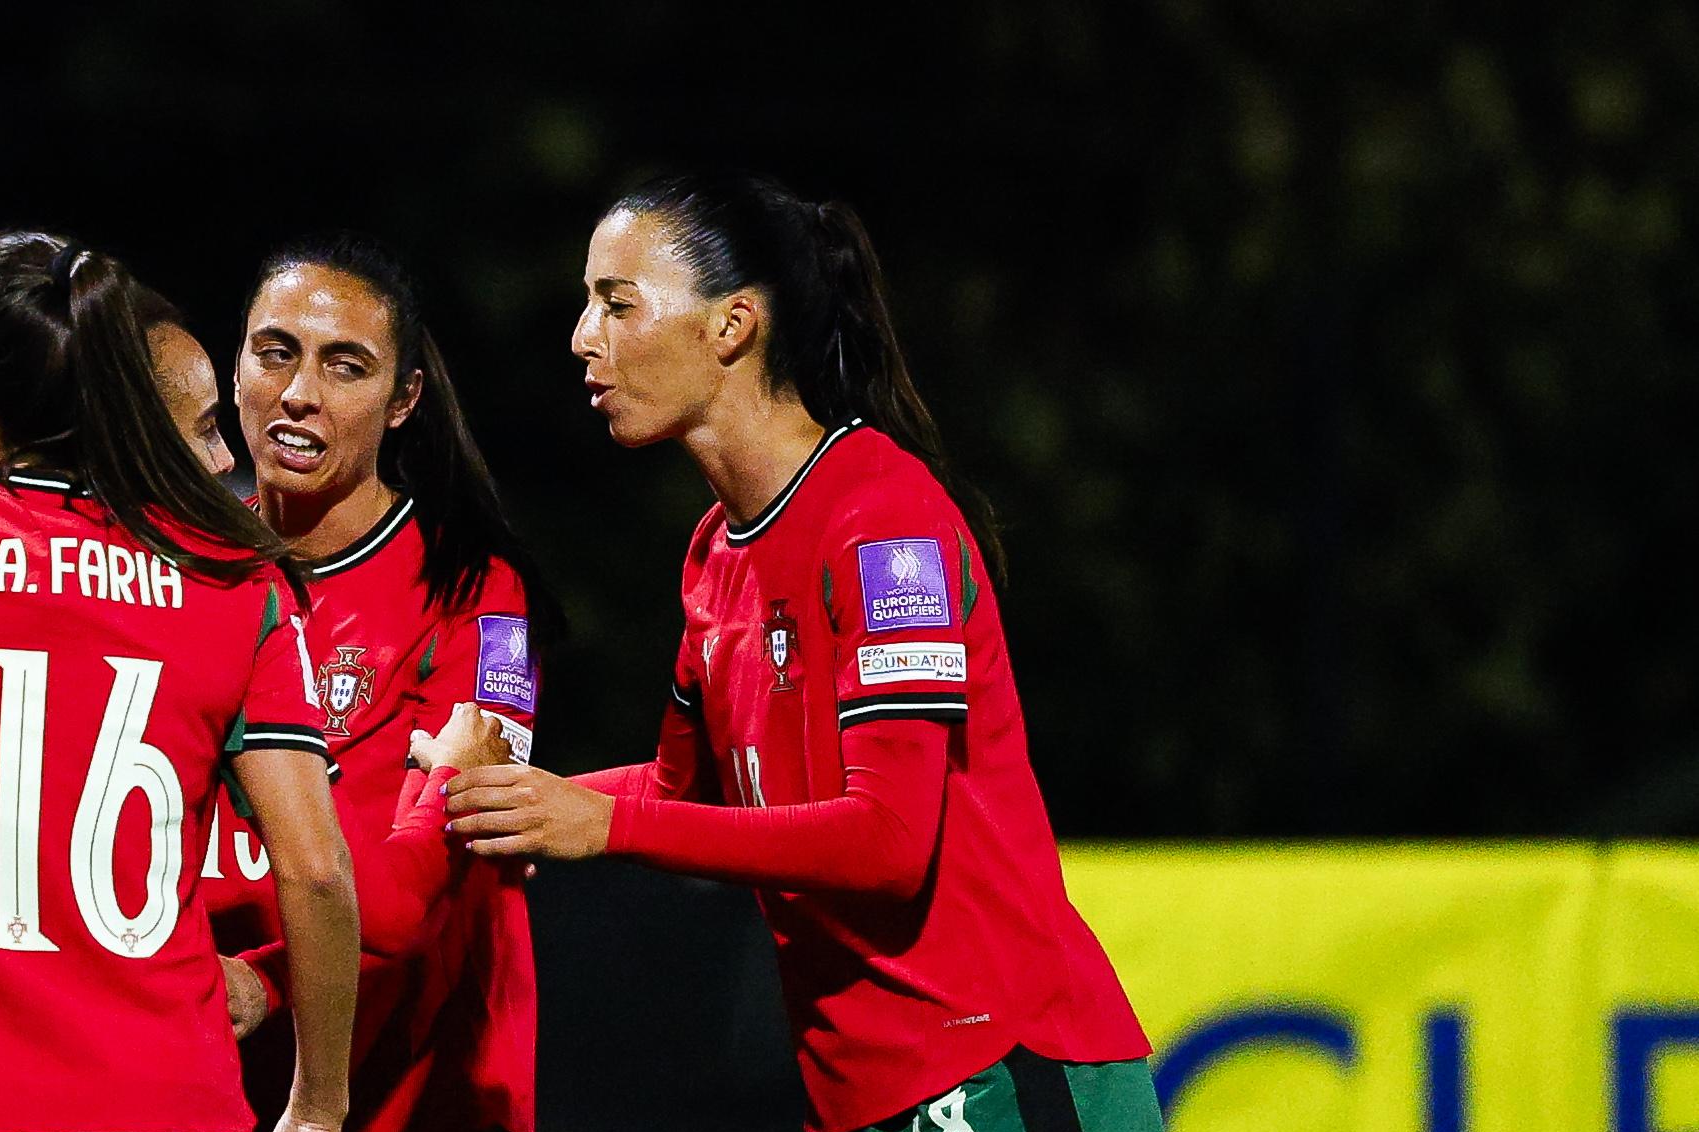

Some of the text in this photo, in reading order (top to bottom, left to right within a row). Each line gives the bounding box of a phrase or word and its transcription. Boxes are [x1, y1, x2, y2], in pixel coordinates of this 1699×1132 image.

[50, 537, 183, 609] FARIA
[872, 594, 940, 610] EUROPEAN
[872, 605, 942, 621] QUALIFIERS
[861, 648, 885, 657] UEFA
[861, 655, 963, 671] FOUNDATION
